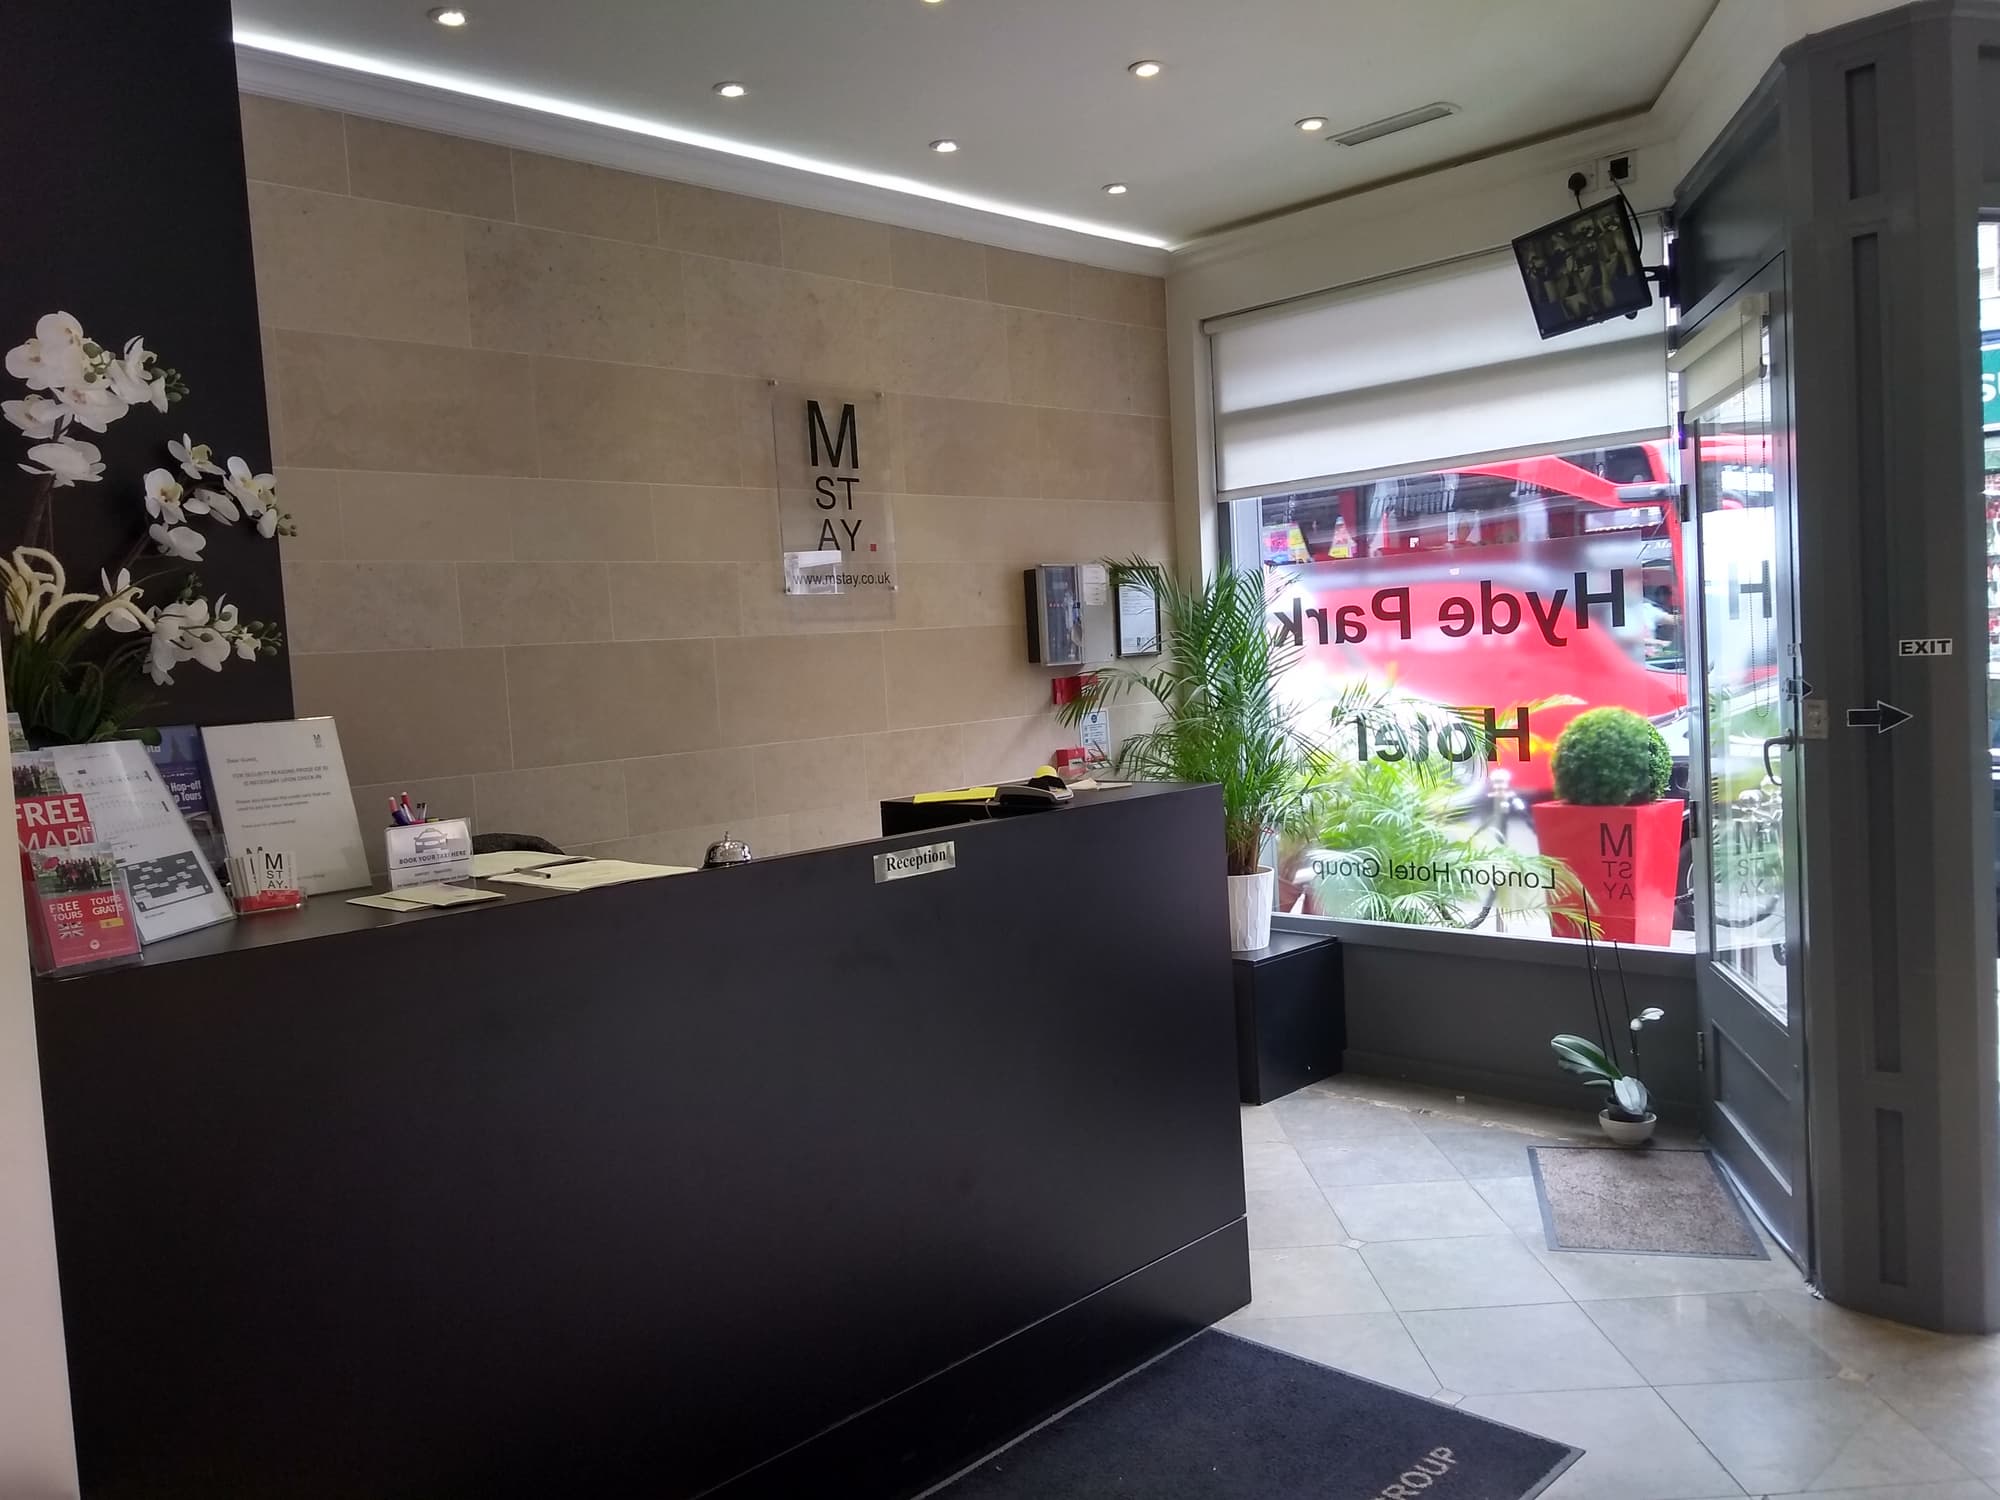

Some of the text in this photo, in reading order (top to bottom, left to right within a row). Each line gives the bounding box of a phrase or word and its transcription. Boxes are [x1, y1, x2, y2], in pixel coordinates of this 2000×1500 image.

[807, 400, 859, 469] M
[815, 476, 860, 510] ST
[792, 572, 891, 587] www.mstay.co.uk
[1901, 640, 1951, 655] EXIT
[1600, 823, 1633, 857] M
[265, 853, 283, 870] M
[886, 849, 946, 871] Reception
[266, 870, 284, 879] ST
[49, 901, 80, 913] FREE
[52, 910, 84, 921] TOURS
[1371, 1447, 1457, 1500] ROUP
